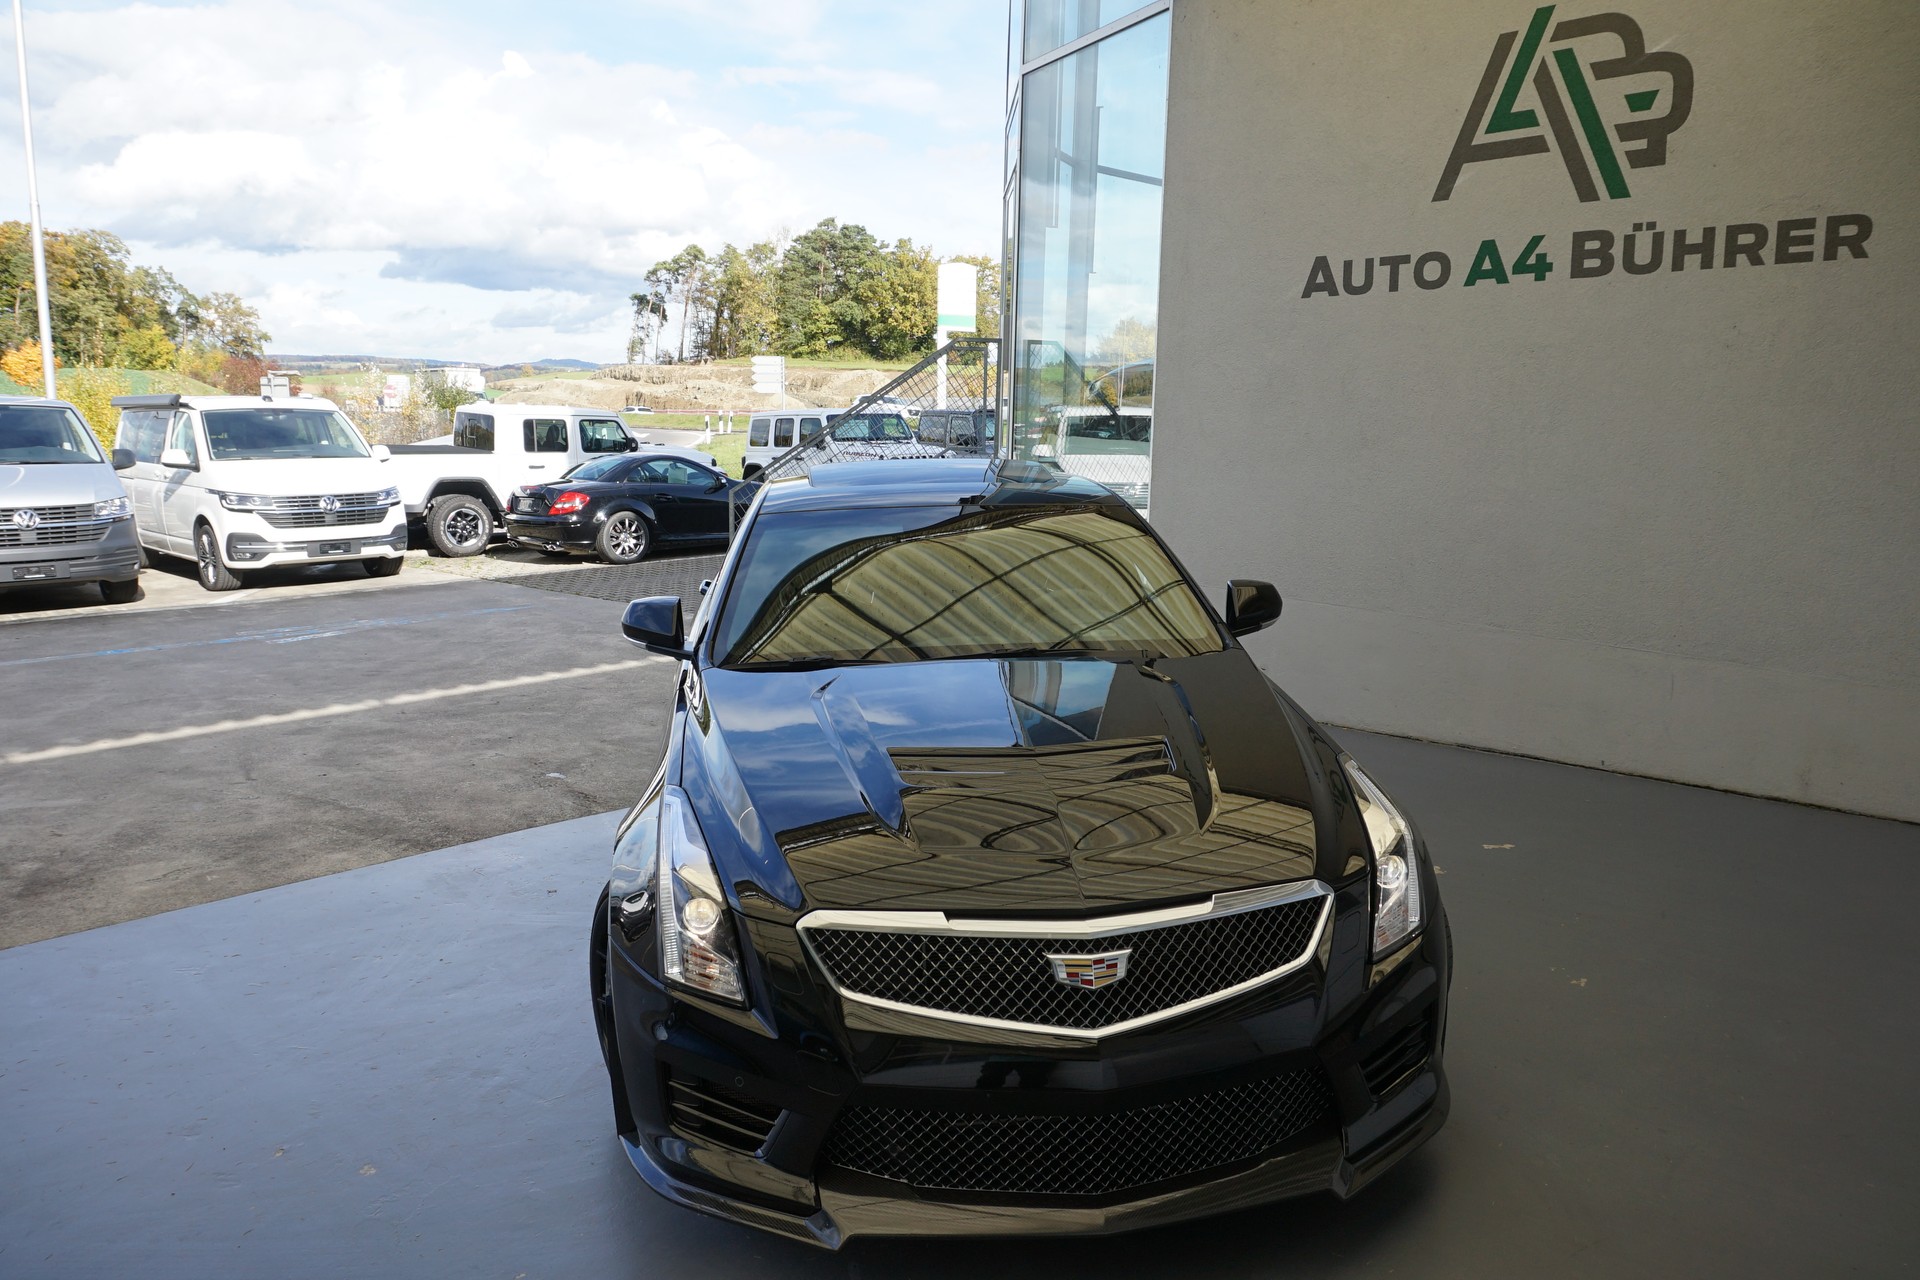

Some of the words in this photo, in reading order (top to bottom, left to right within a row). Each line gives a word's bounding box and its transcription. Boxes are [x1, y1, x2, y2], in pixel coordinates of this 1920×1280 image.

[1300, 251, 1452, 300] AUTO
[1462, 234, 1554, 288] A4
[1569, 213, 1874, 280] BÜHRER
